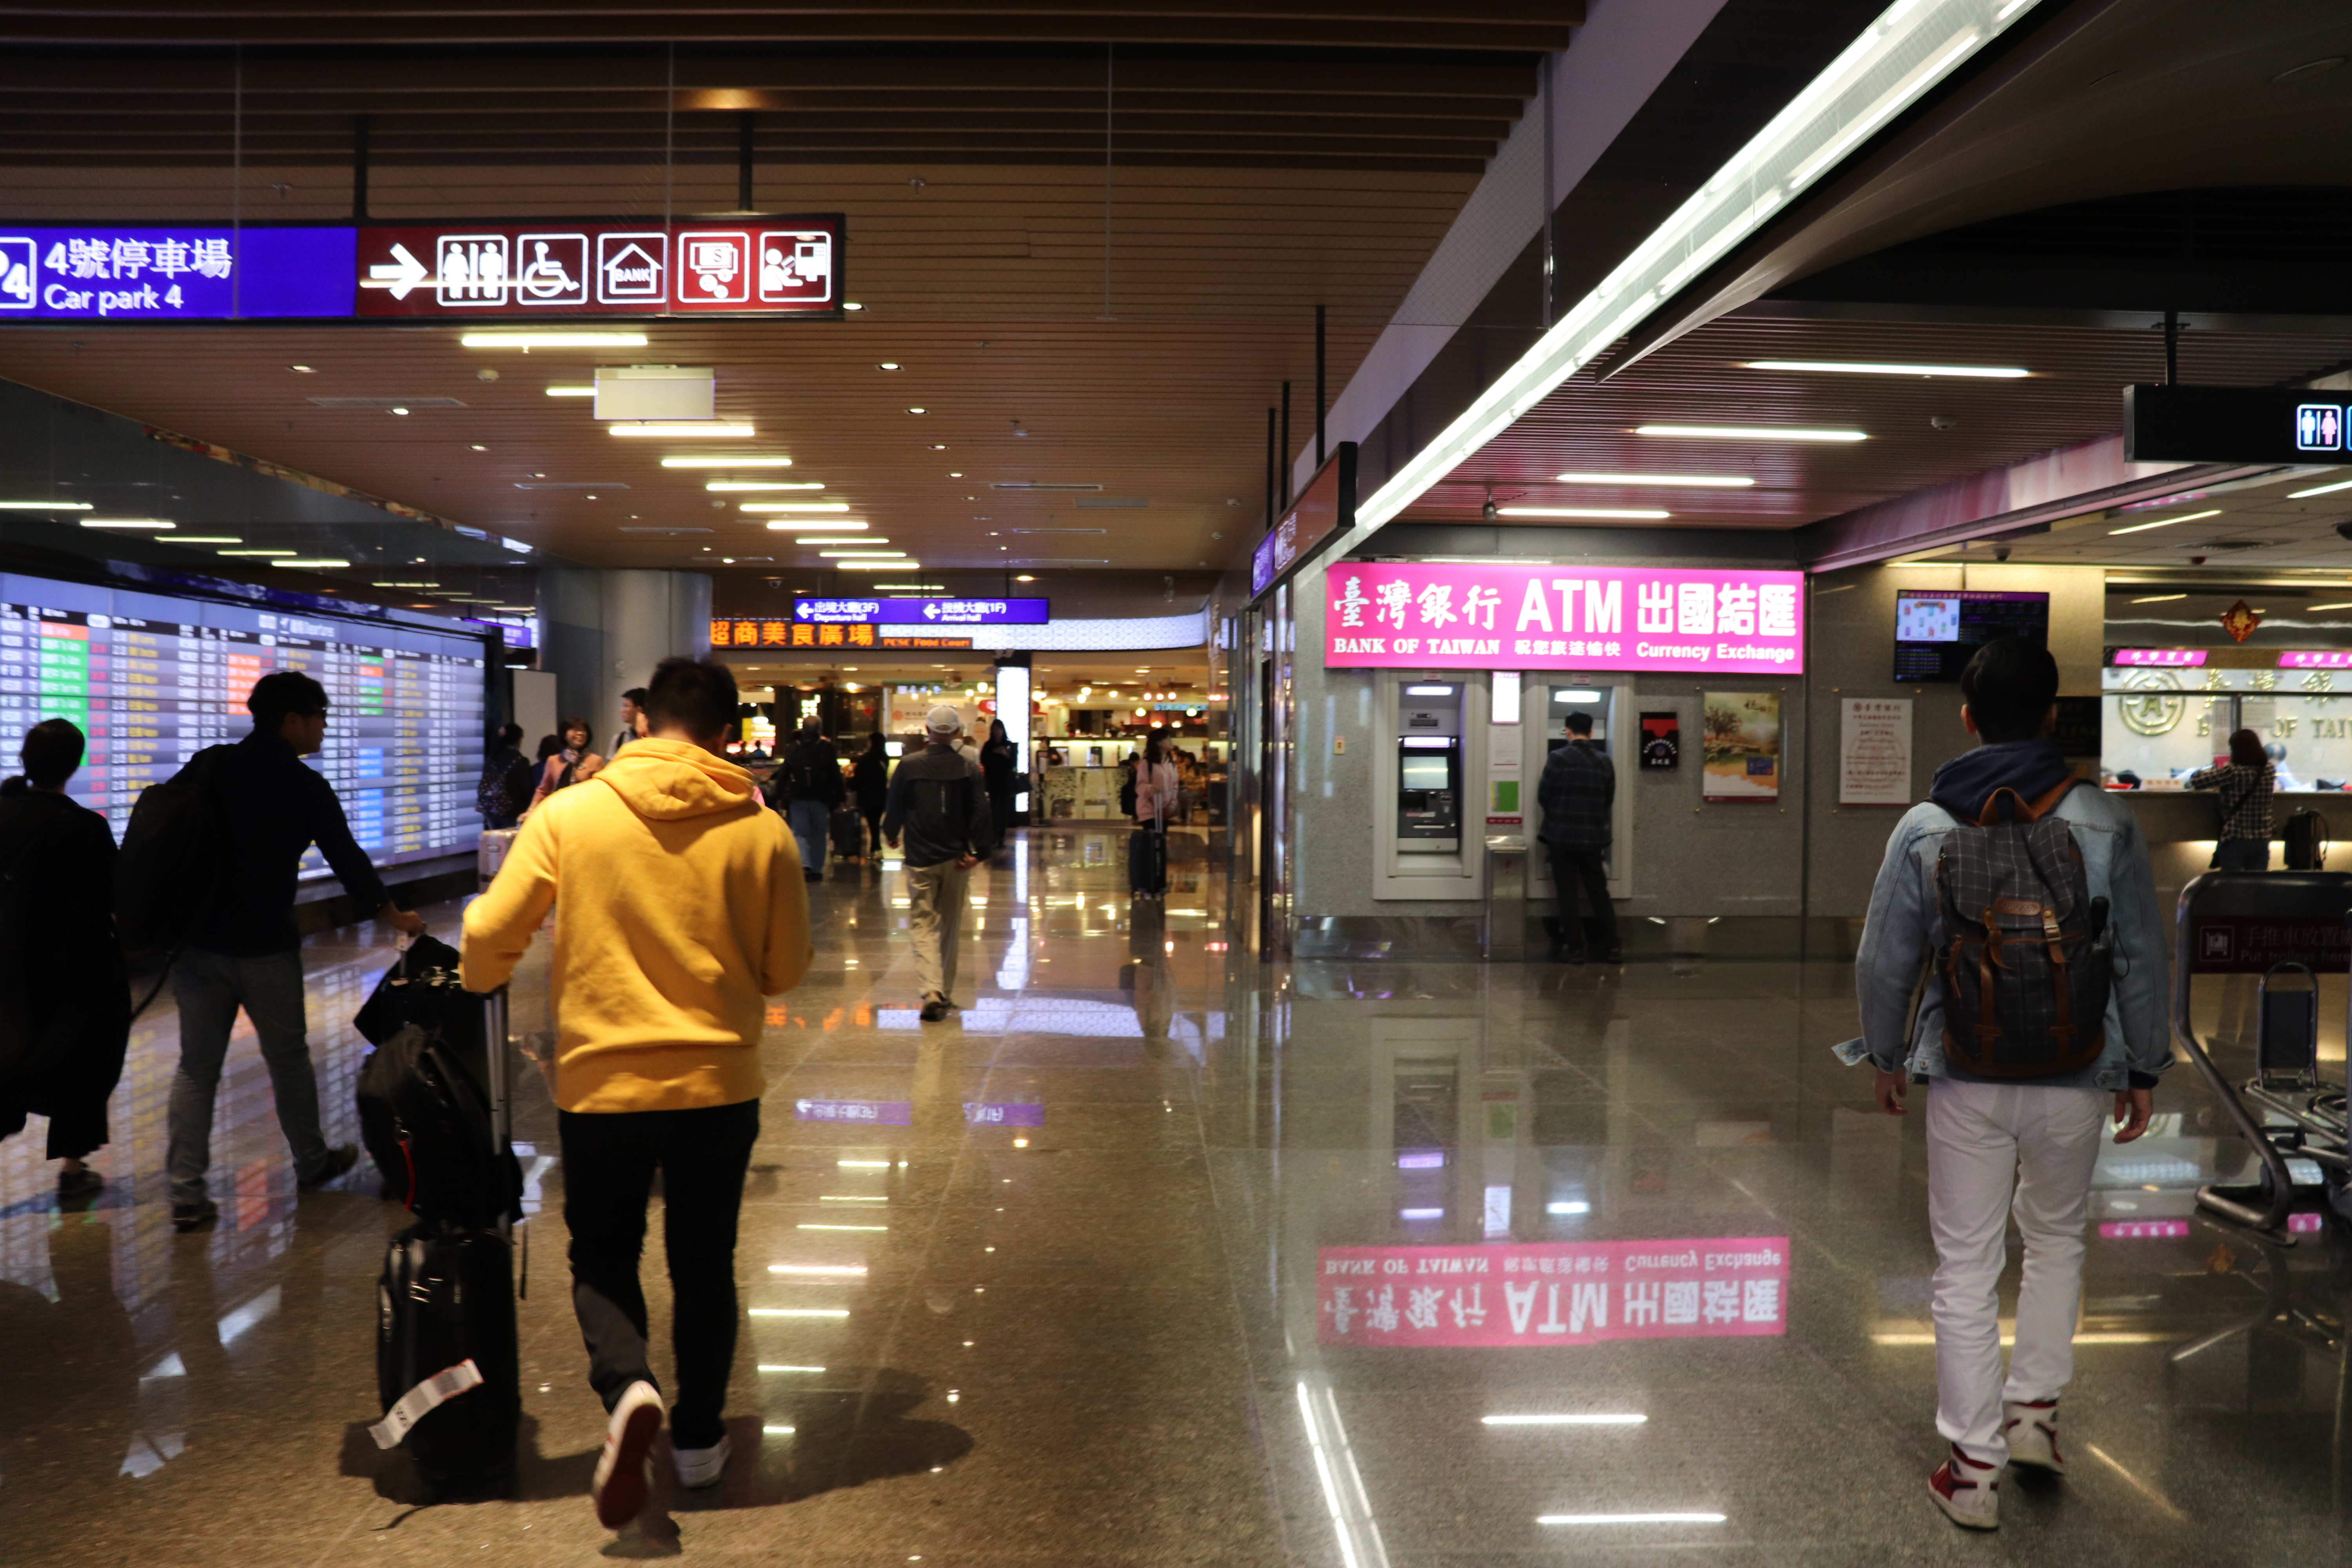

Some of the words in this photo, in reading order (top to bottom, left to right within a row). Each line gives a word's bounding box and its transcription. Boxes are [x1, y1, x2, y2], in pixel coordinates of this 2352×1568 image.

[44, 238, 232, 279] 4號停車場
[615, 268, 650, 282] BANK
[44, 283, 94, 310] Car
[98, 283, 160, 316] park
[164, 284, 184, 309] 4
[1334, 576, 1501, 630] 臺灣銀行
[1515, 579, 1622, 633] ATM
[1637, 581, 1796, 636] 出國結匯
[814, 613, 852, 622] Departure
[852, 613, 867, 621] hall
[710, 621, 873, 646] 超商美食廣場
[913, 638, 940, 646] Food
[942, 638, 971, 646] Court
[1334, 638, 1386, 653] BANK
[1393, 639, 1419, 654] OF
[1427, 639, 1500, 655] TAIWAN
[1514, 639, 1621, 657] 祝您旅途愉快
[1637, 642, 1711, 662] Currency
[1717, 643, 1795, 663] Exchange
[2311, 717, 2352, 738] TAI
[2241, 949, 2262, 962] Put
[2268, 949, 2316, 963] trolleys
